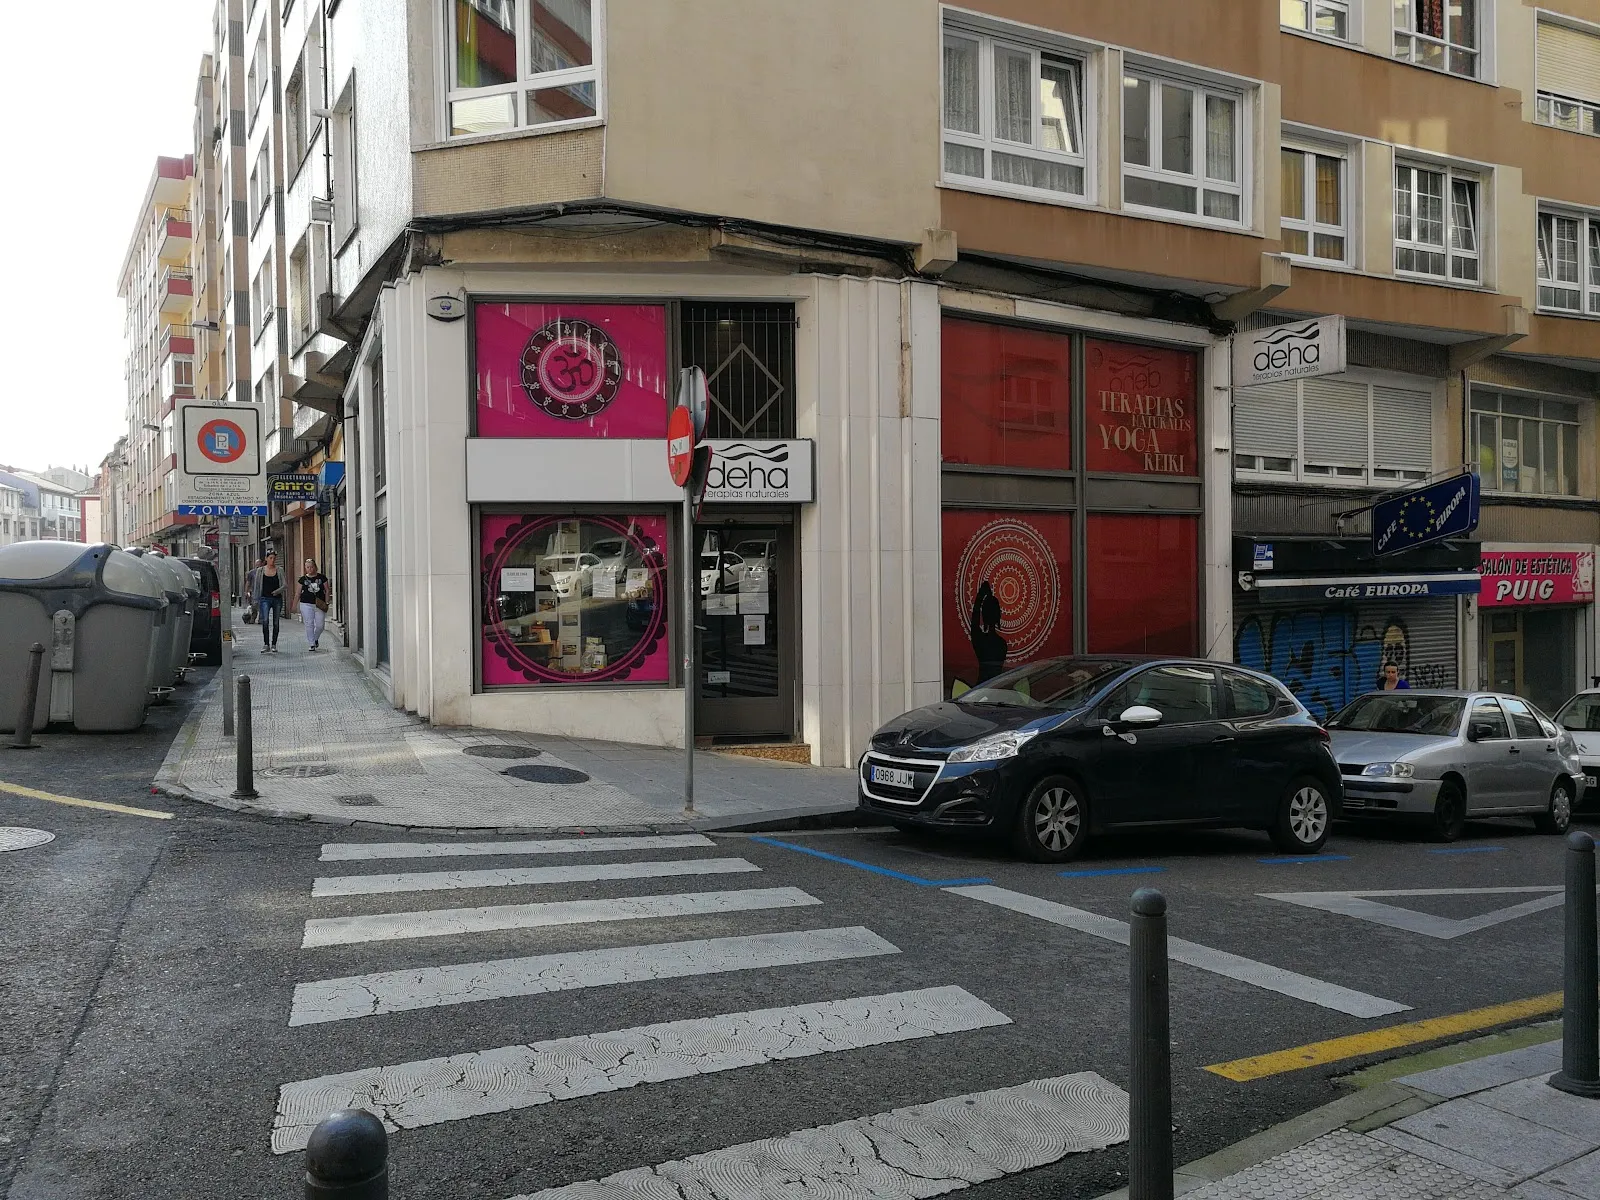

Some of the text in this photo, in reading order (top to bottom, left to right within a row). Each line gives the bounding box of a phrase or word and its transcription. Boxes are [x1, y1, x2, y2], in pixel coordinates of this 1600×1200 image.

[1253, 342, 1320, 371] deha
[1252, 364, 1319, 380] terapias naturales
[1098, 390, 1184, 418] TERAPIAS
[1132, 414, 1191, 431] NATURALES
[1099, 423, 1161, 454] YOGA
[1143, 452, 1184, 473] REIKI
[706, 460, 789, 489] deha
[274, 481, 315, 491] anro
[746, 489, 789, 498] naturales
[188, 505, 259, 515] ZONA 2
[1435, 486, 1467, 532] EUROPA
[1480, 554, 1572, 577] SALÓN DE ESTÉTICA
[1325, 583, 1430, 598] Café EUROPA
[1496, 579, 1554, 602] PUIG
[876, 768, 895, 782] 0968
